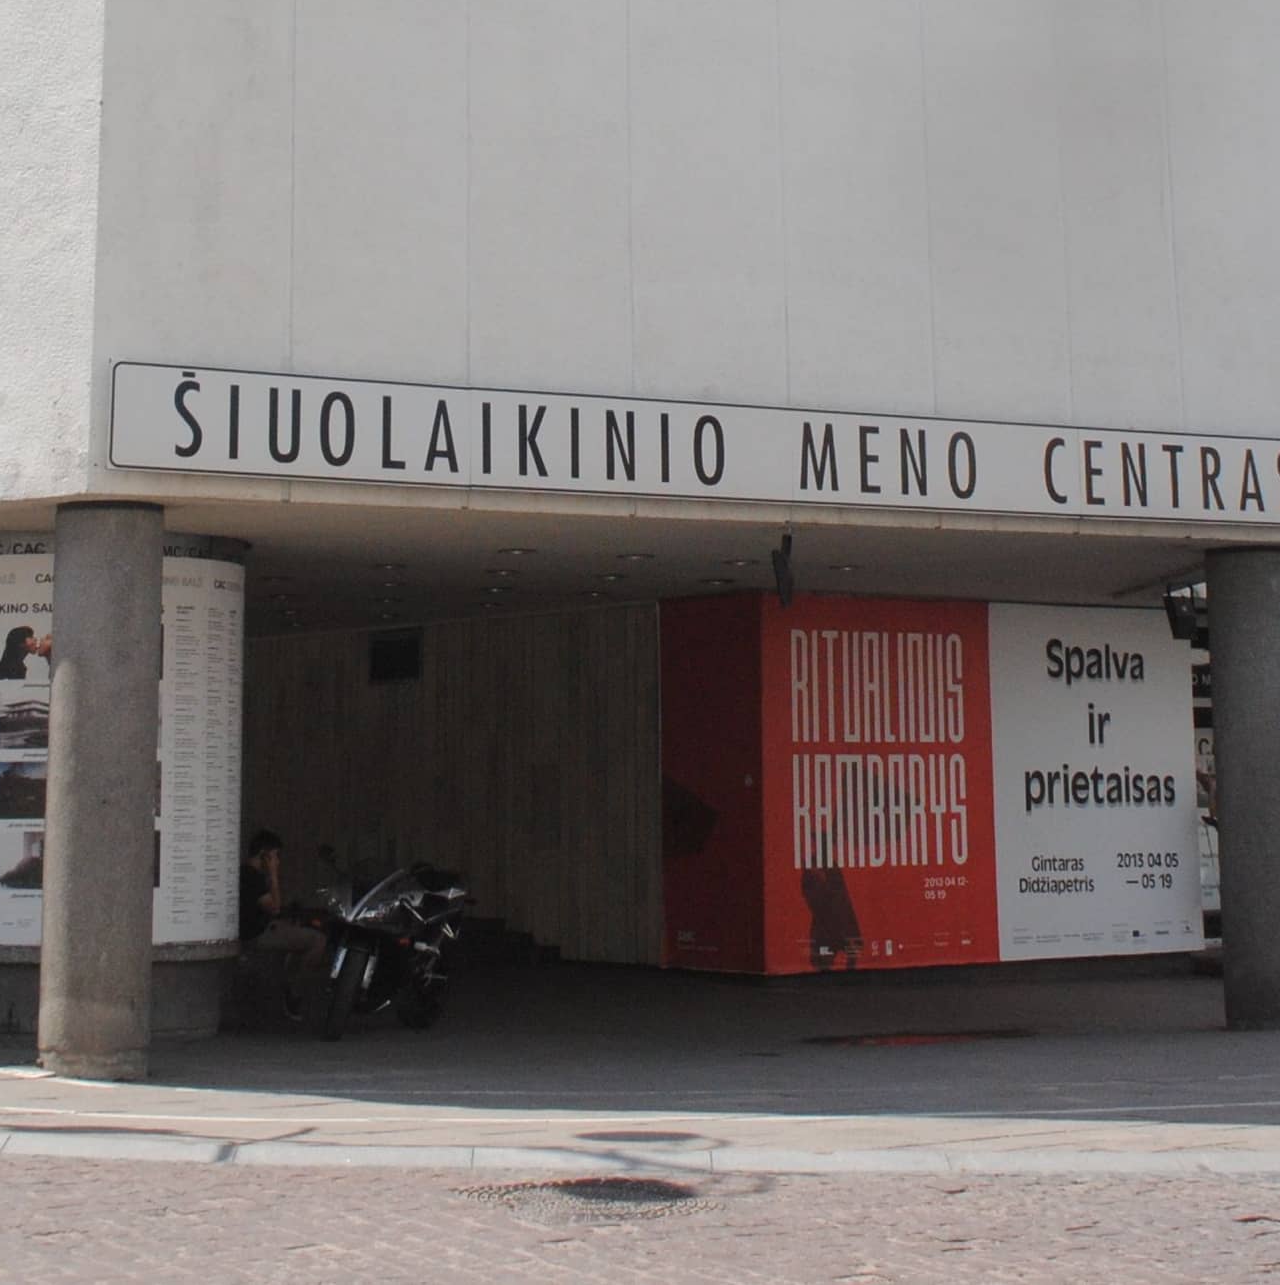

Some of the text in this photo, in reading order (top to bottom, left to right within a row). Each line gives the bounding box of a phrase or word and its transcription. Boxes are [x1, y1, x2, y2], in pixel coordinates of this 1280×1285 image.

[173, 371, 725, 486] ŠIUOLAIKINIO
[800, 421, 977, 500] MENO
[34, 572, 55, 584] CA
[31, 602, 54, 613] SAL
[1045, 637, 1145, 687] Spalva
[790, 628, 965, 744] RITUALINIS
[1087, 702, 1112, 745] ir
[1024, 763, 1176, 813] prietaisas
[792, 753, 969, 870] KAMBARYS
[1031, 854, 1085, 872] Gintaras
[1116, 853, 1180, 868] 2013 04 05
[1019, 876, 1095, 895] Didžiapetris
[1141, 874, 1156, 889] 05
[1158, 873, 1173, 888] 19
